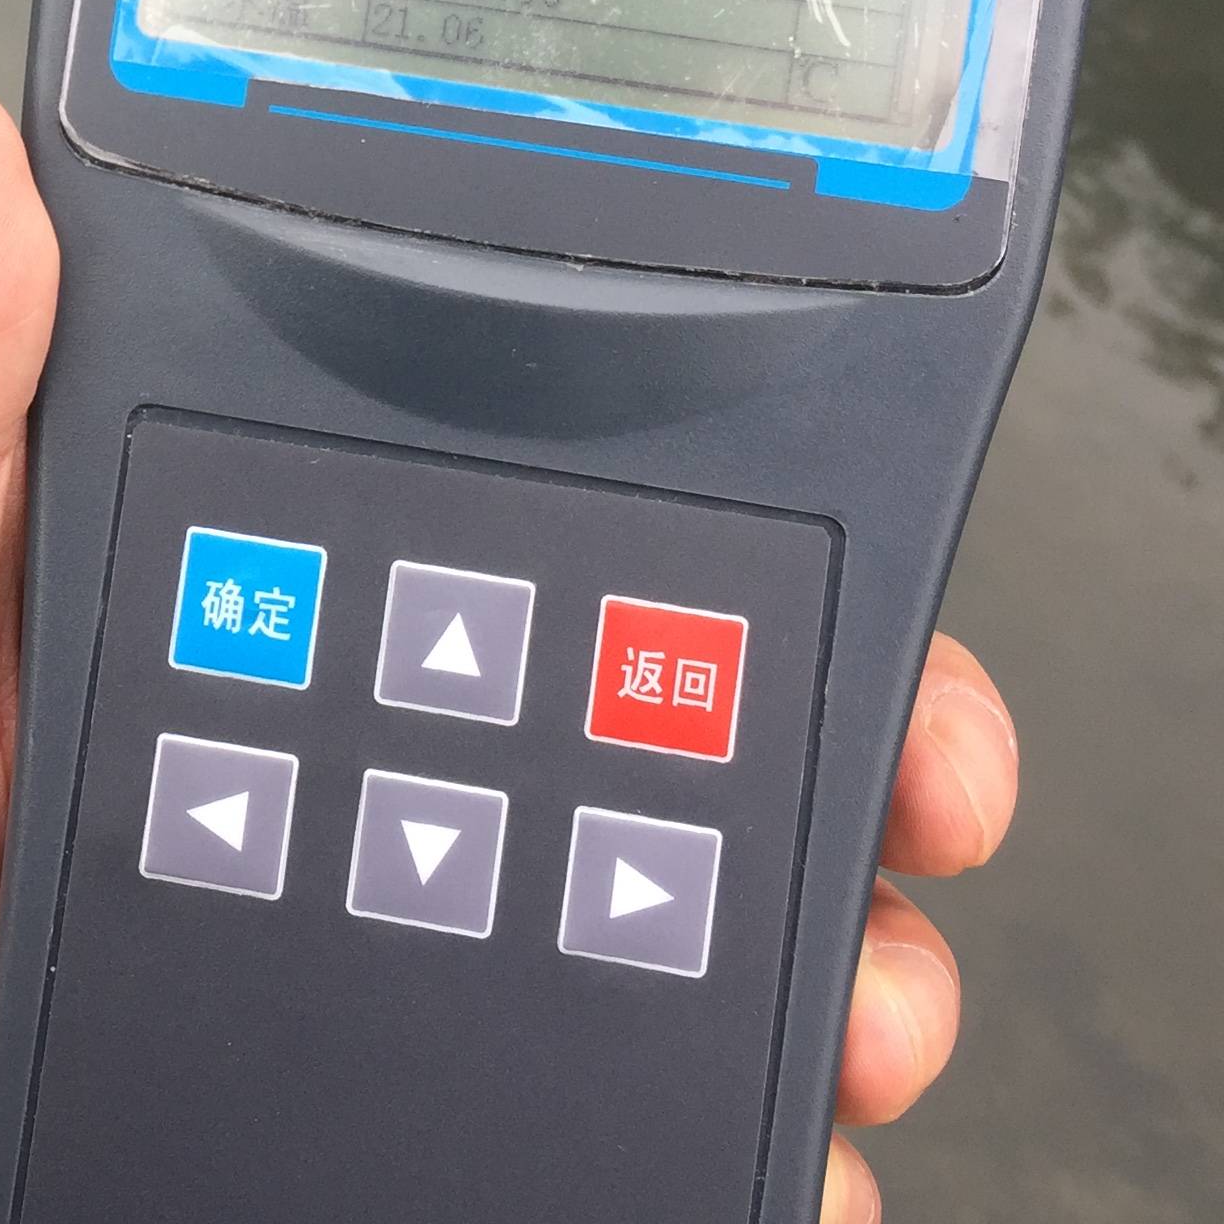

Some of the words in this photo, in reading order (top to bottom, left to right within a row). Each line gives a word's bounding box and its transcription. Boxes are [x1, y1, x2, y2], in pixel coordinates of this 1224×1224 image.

[371, 2, 485, 49] 21.06
[200, 578, 296, 642] 确定
[616, 647, 719, 714] 返回
